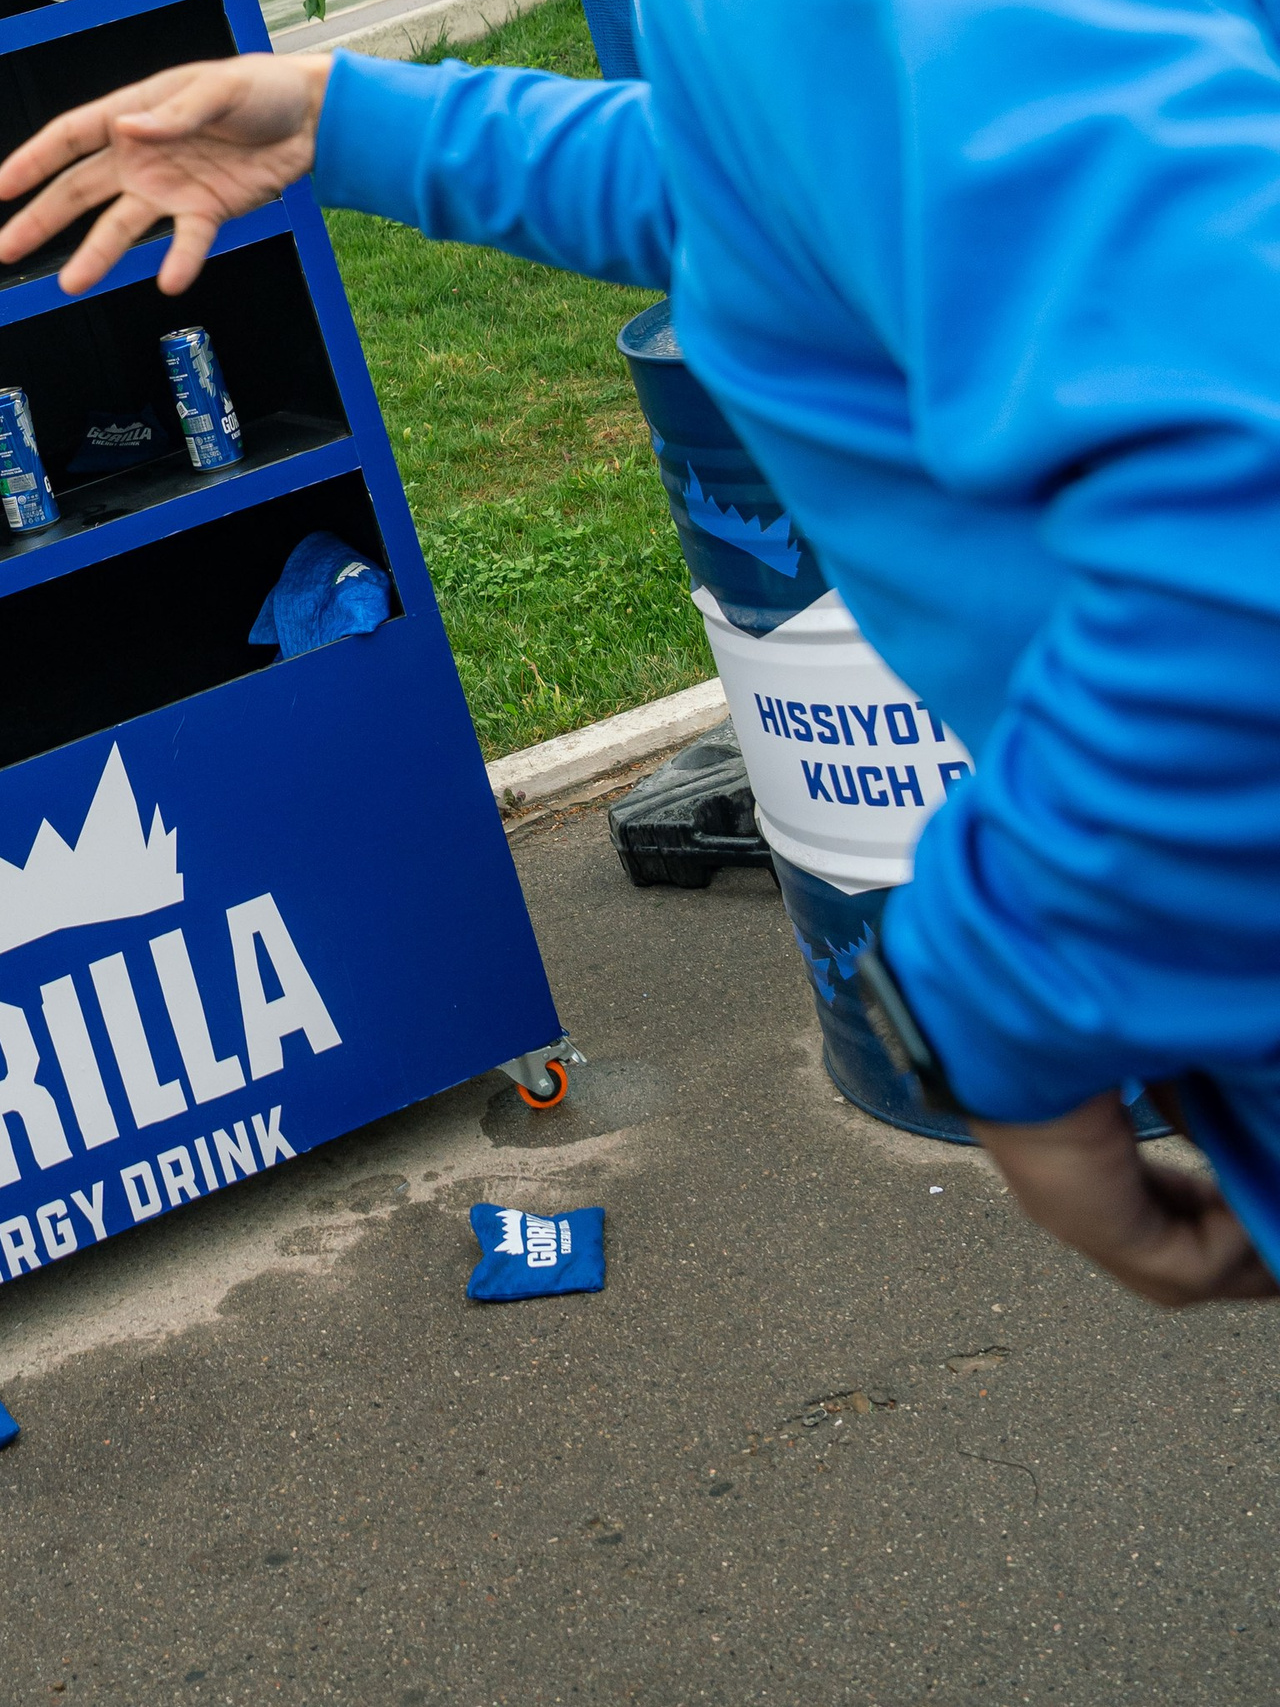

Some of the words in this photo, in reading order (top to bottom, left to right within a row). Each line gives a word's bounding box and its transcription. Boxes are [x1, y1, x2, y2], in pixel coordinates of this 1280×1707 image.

[86, 426, 152, 443] GORILLA
[800, 759, 925, 807] KUCH
[119, 1104, 298, 1223] DRINK
